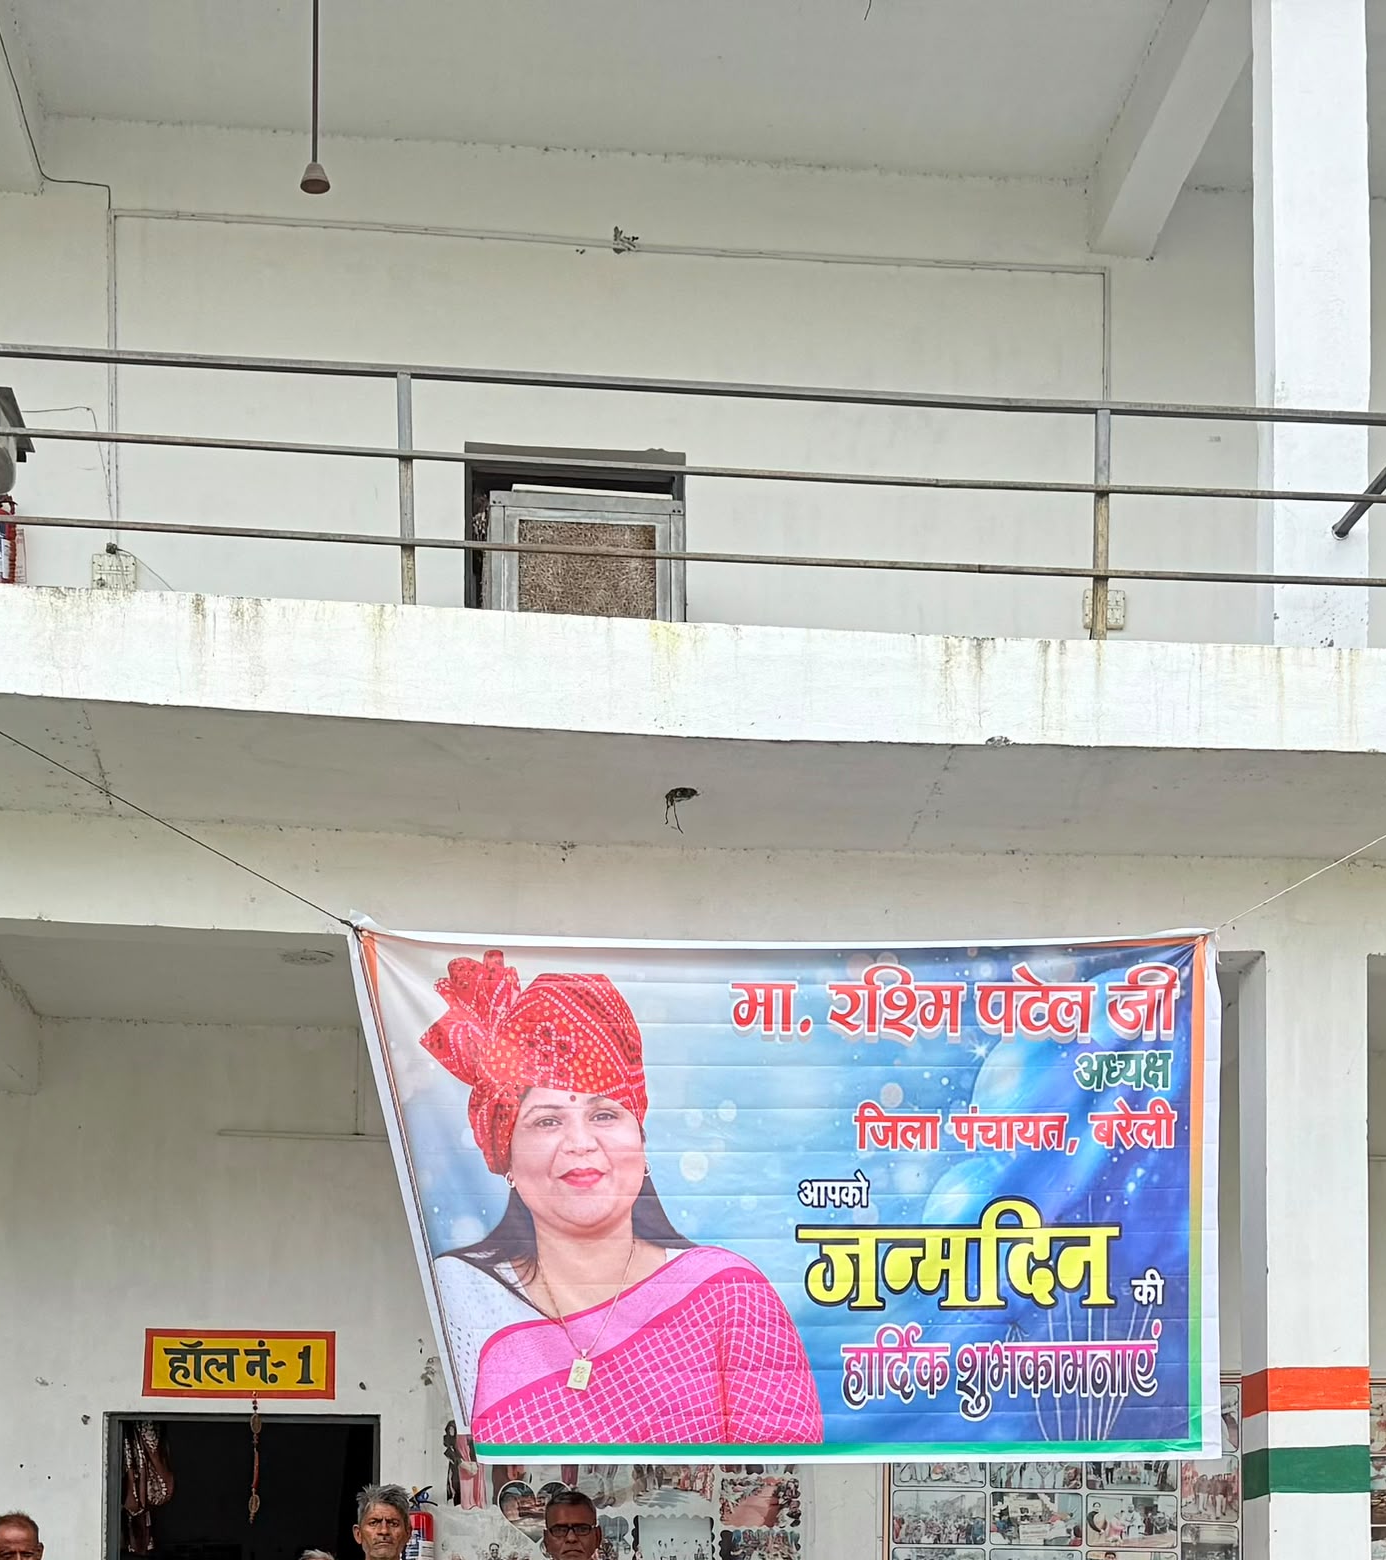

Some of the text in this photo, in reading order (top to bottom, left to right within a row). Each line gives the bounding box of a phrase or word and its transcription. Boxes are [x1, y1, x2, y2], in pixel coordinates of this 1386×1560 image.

[730, 962, 1180, 1038] मा. रश्मि पटेल जी
[1074, 1050, 1172, 1092] अध्यक्ष
[853, 1098, 1178, 1156] जिला पंचायत, बरेली
[797, 1170, 869, 1208] आपको
[795, 1195, 1165, 1311] जन्मदिन की
[163, 1340, 240, 1388] हॉल
[296, 1345, 315, 1384] 1
[840, 1319, 1163, 1421] हार्दिक शुभकामनाएं
